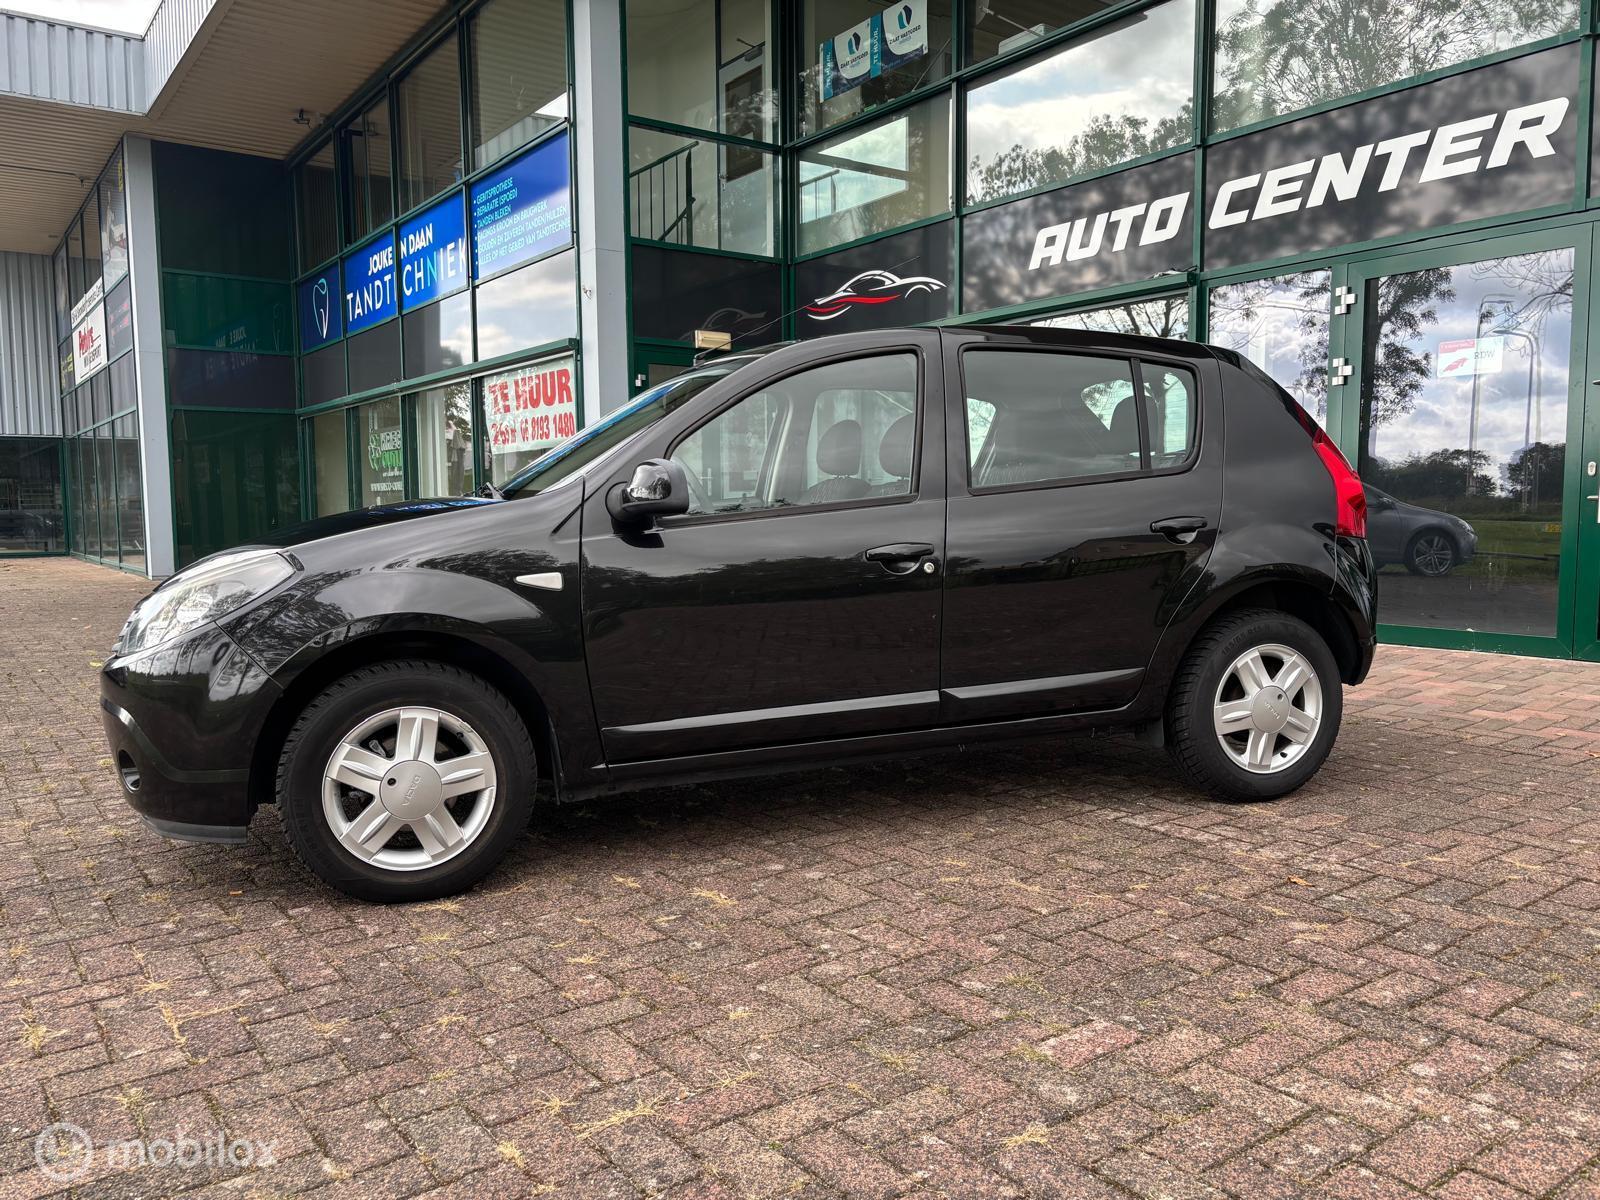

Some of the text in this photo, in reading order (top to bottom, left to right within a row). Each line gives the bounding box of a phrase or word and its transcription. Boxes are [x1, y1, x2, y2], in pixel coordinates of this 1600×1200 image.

[1028, 96, 1570, 271] AUTO CENTER
[476, 197, 499, 217] REPARATIE
[477, 204, 512, 229] TANDEN BLEKEN
[368, 246, 393, 276] JOUKE
[408, 223, 433, 255] DAAN
[346, 238, 466, 322] TANDTCHNIEK
[1474, 349, 1496, 360] RDW
[488, 368, 573, 415] TE HUUR
[531, 414, 550, 441] 8193
[553, 411, 575, 439] 1480
